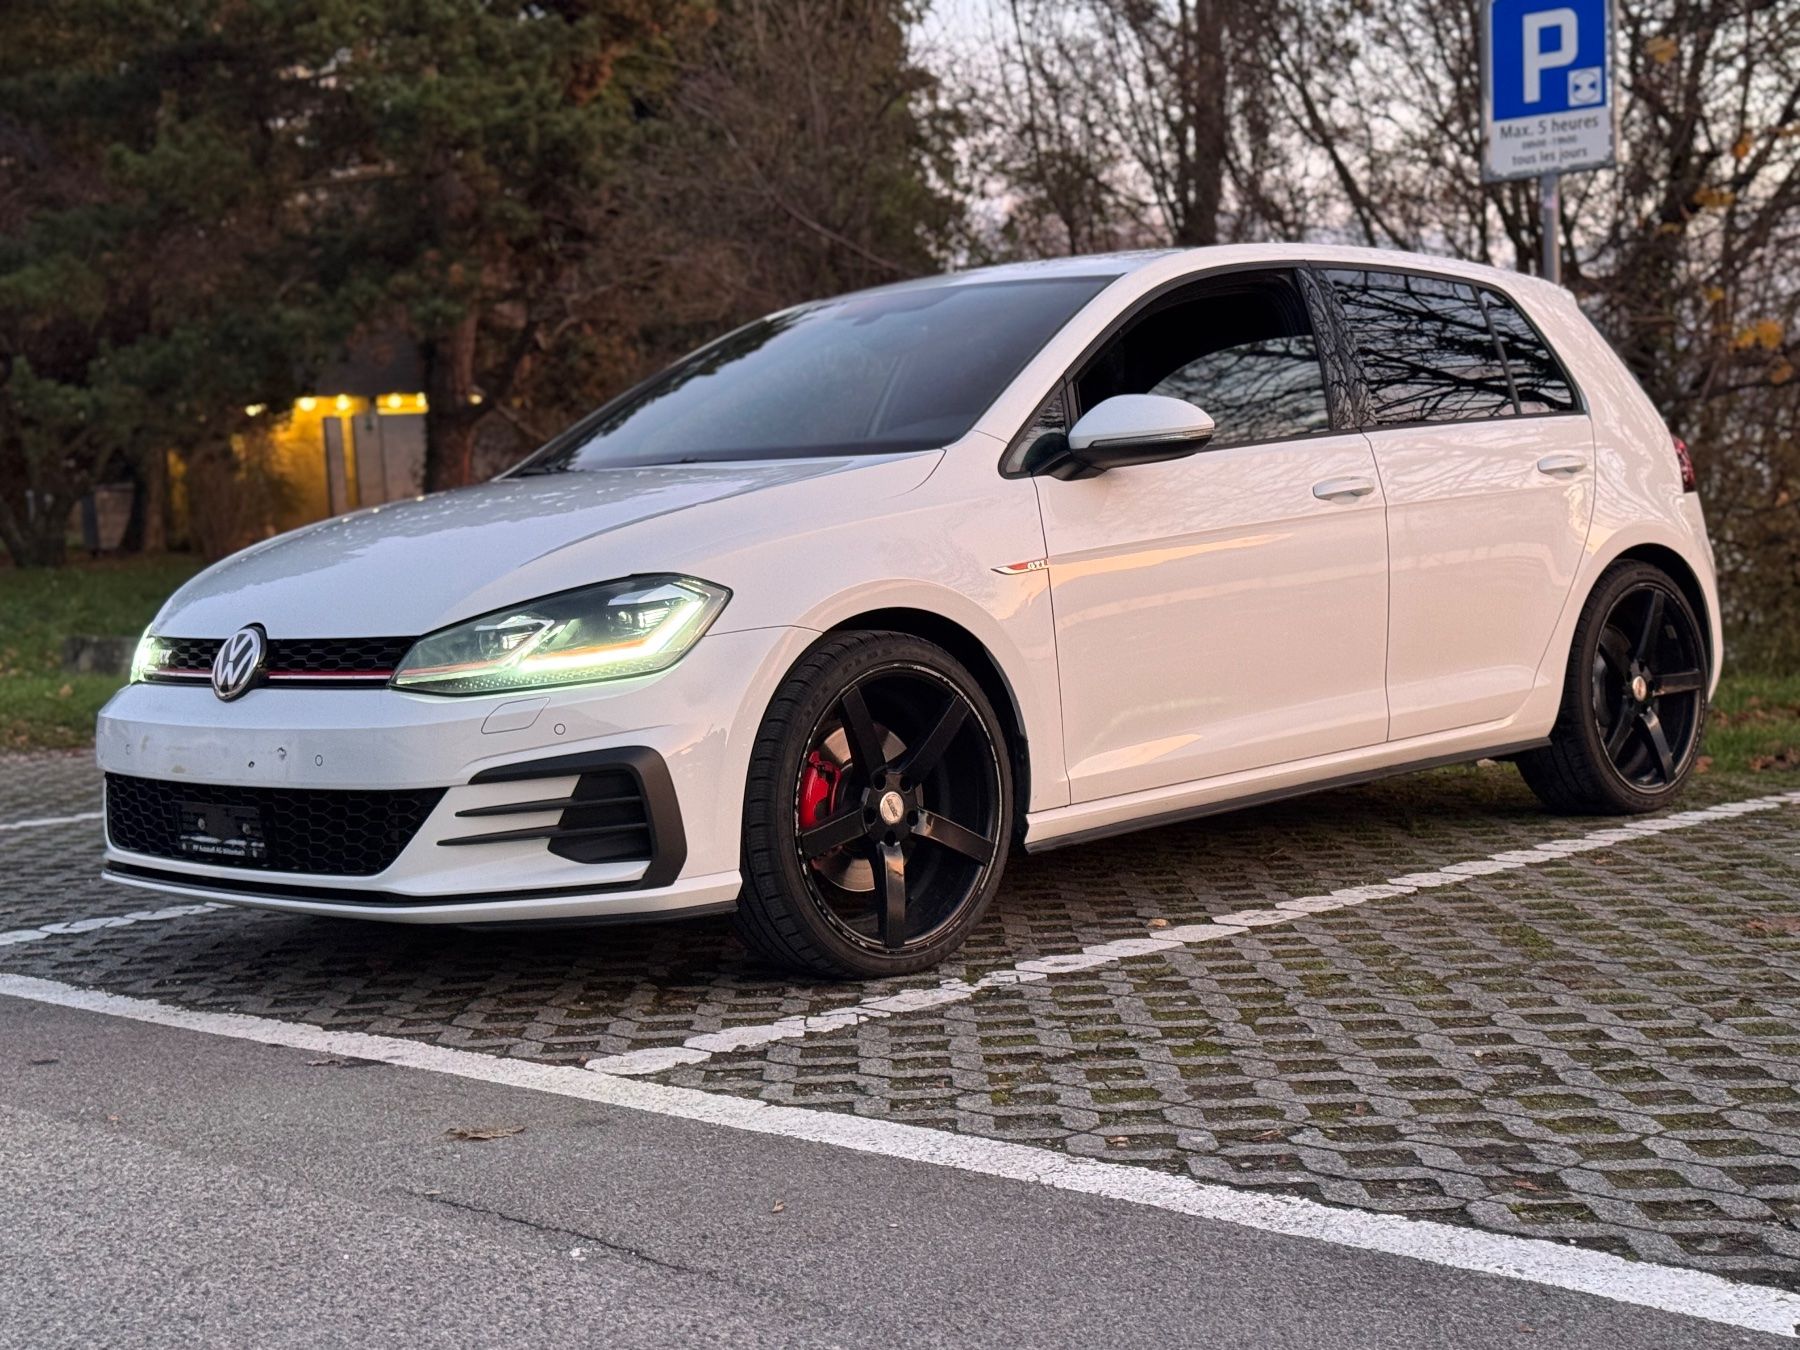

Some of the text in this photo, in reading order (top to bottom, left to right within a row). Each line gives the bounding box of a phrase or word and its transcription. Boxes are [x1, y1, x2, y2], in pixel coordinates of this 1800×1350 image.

[1522, 7, 1579, 104] P
[1500, 115, 1599, 139] Max. 5 heures
[1512, 146, 1588, 166] tous les jours
